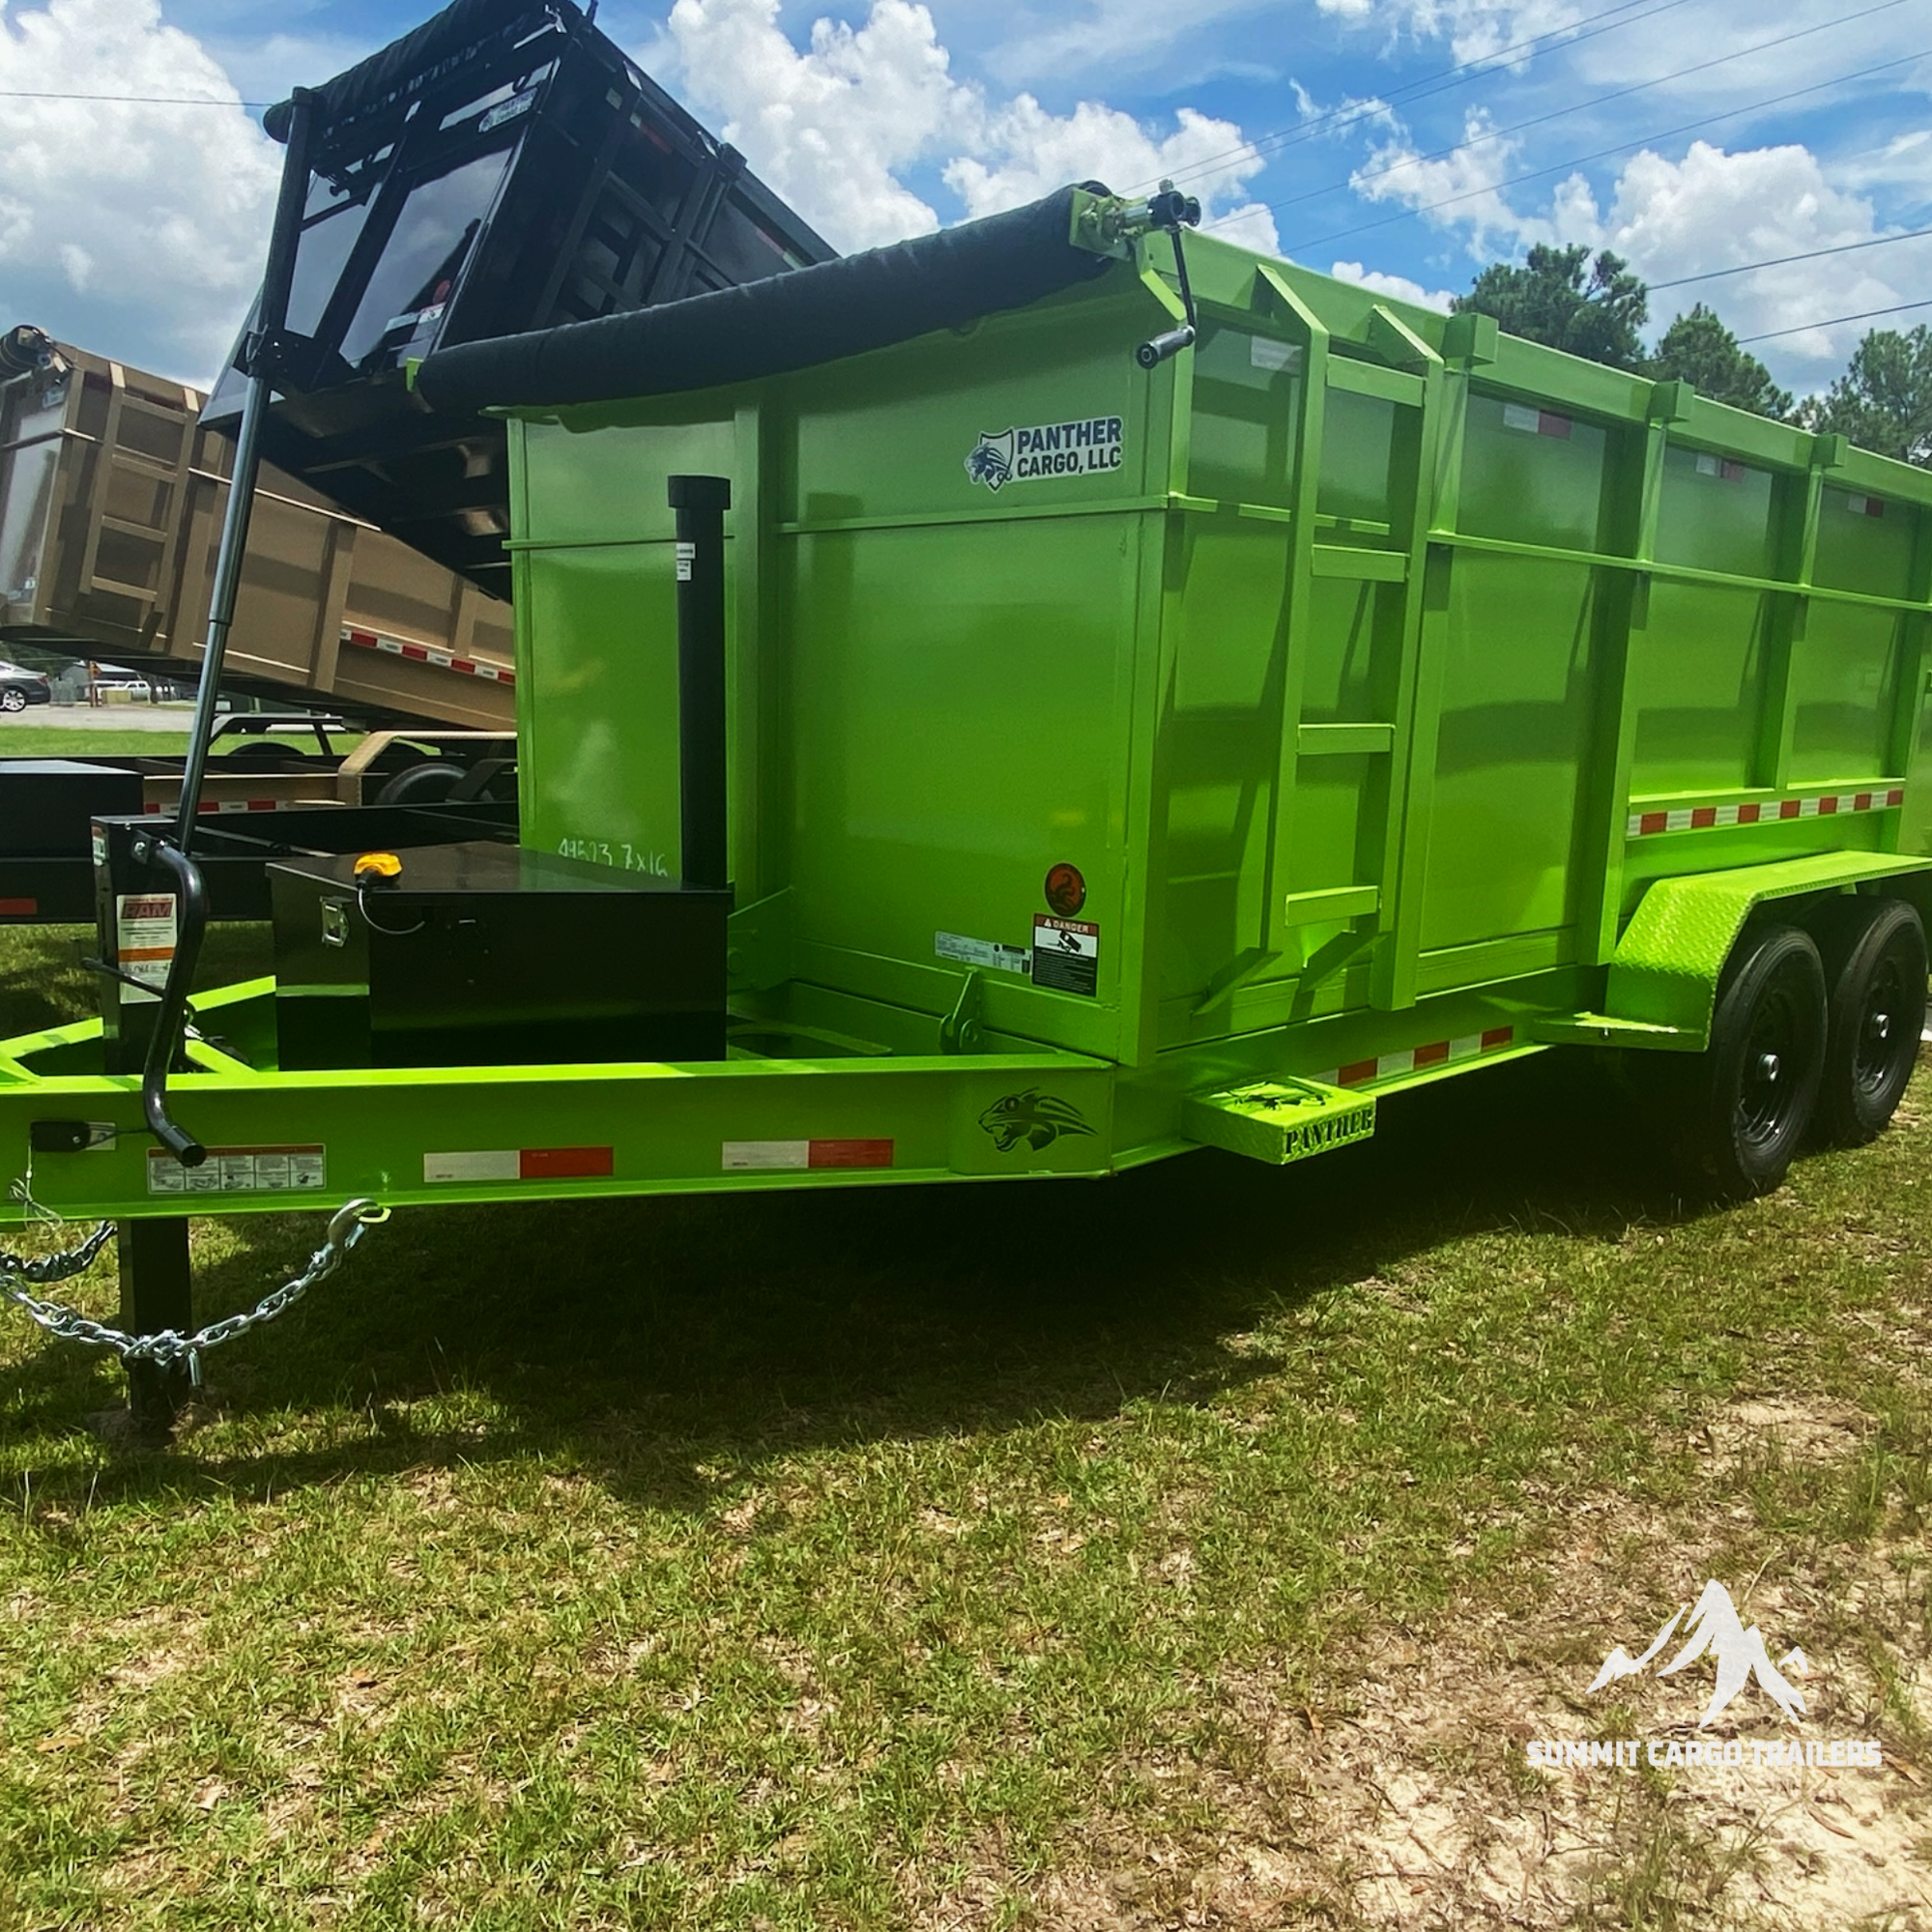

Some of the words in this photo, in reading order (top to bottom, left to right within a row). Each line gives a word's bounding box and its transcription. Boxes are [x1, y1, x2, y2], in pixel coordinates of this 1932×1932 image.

[1018, 418, 1122, 455] PANTHER
[1018, 450, 1083, 478] CARGO,
[1088, 447, 1122, 470] LLC
[124, 903, 171, 919] RAM
[1053, 920, 1089, 933] DANGER
[1283, 1109, 1373, 1155] PANTHER
